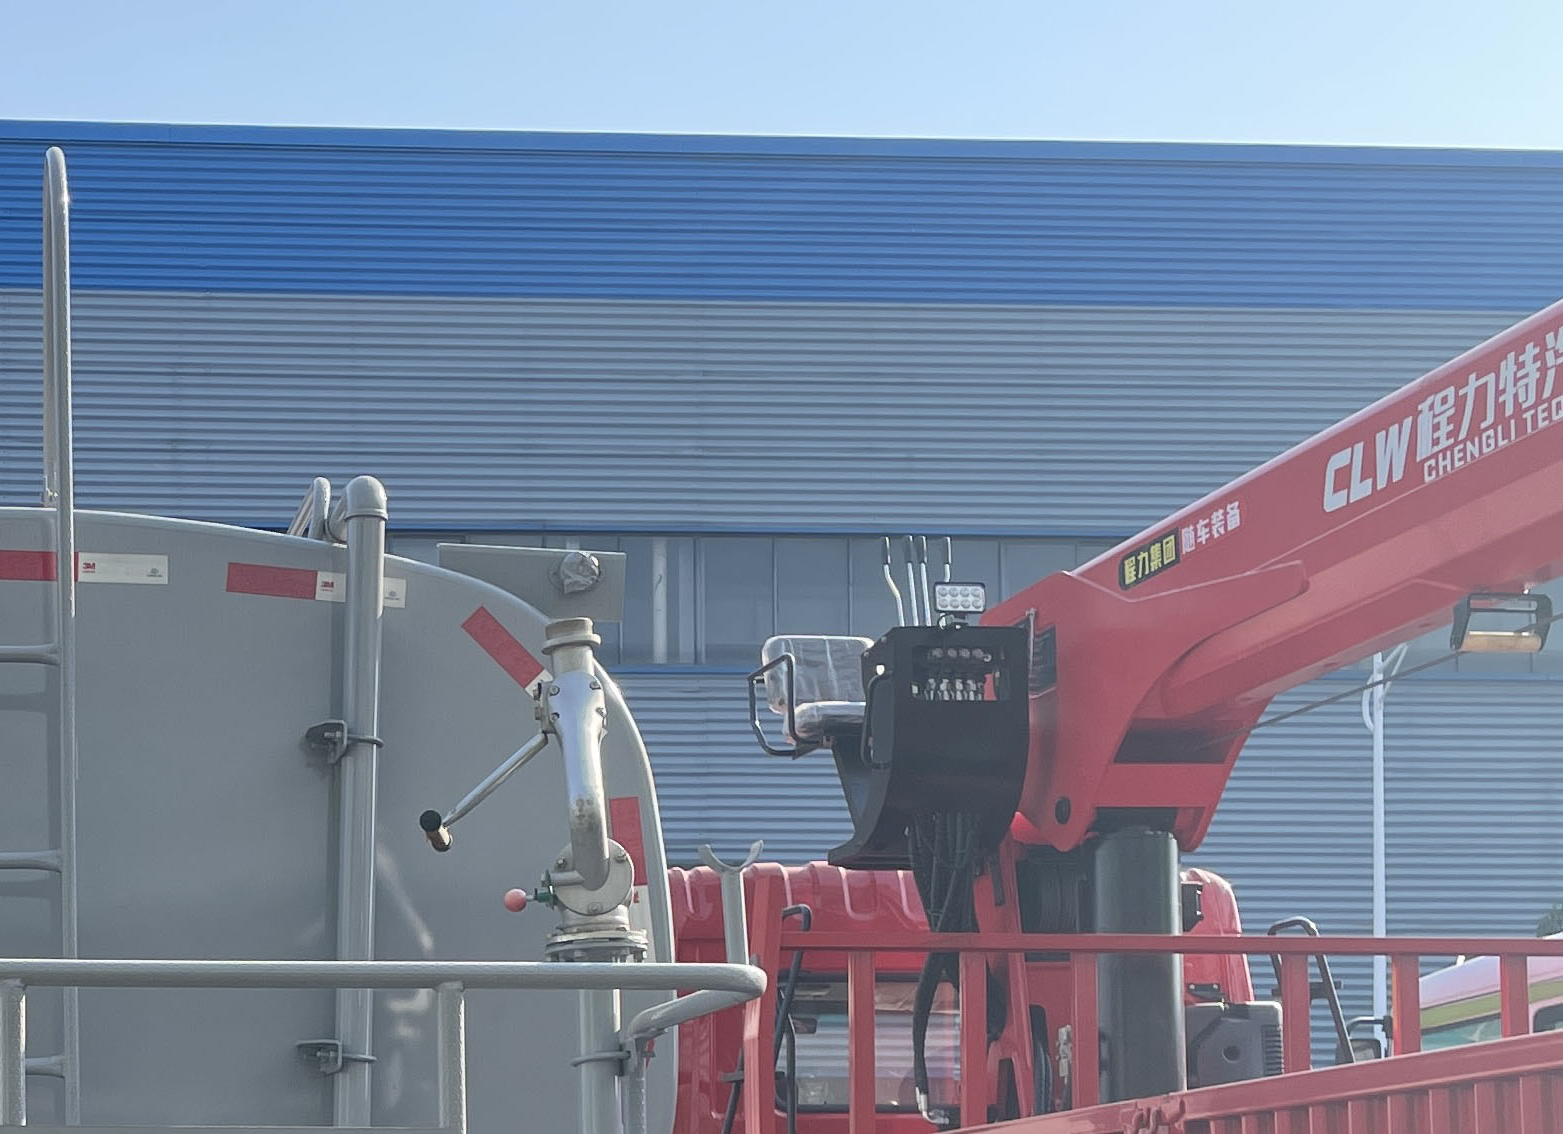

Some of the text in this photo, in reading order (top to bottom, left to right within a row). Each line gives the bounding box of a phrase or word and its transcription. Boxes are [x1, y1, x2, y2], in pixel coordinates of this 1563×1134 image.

[1323, 416, 1413, 513] CLW
[1423, 418, 1516, 484] CHENGLI
[1124, 500, 1240, 585] 程力集团 随车装备
